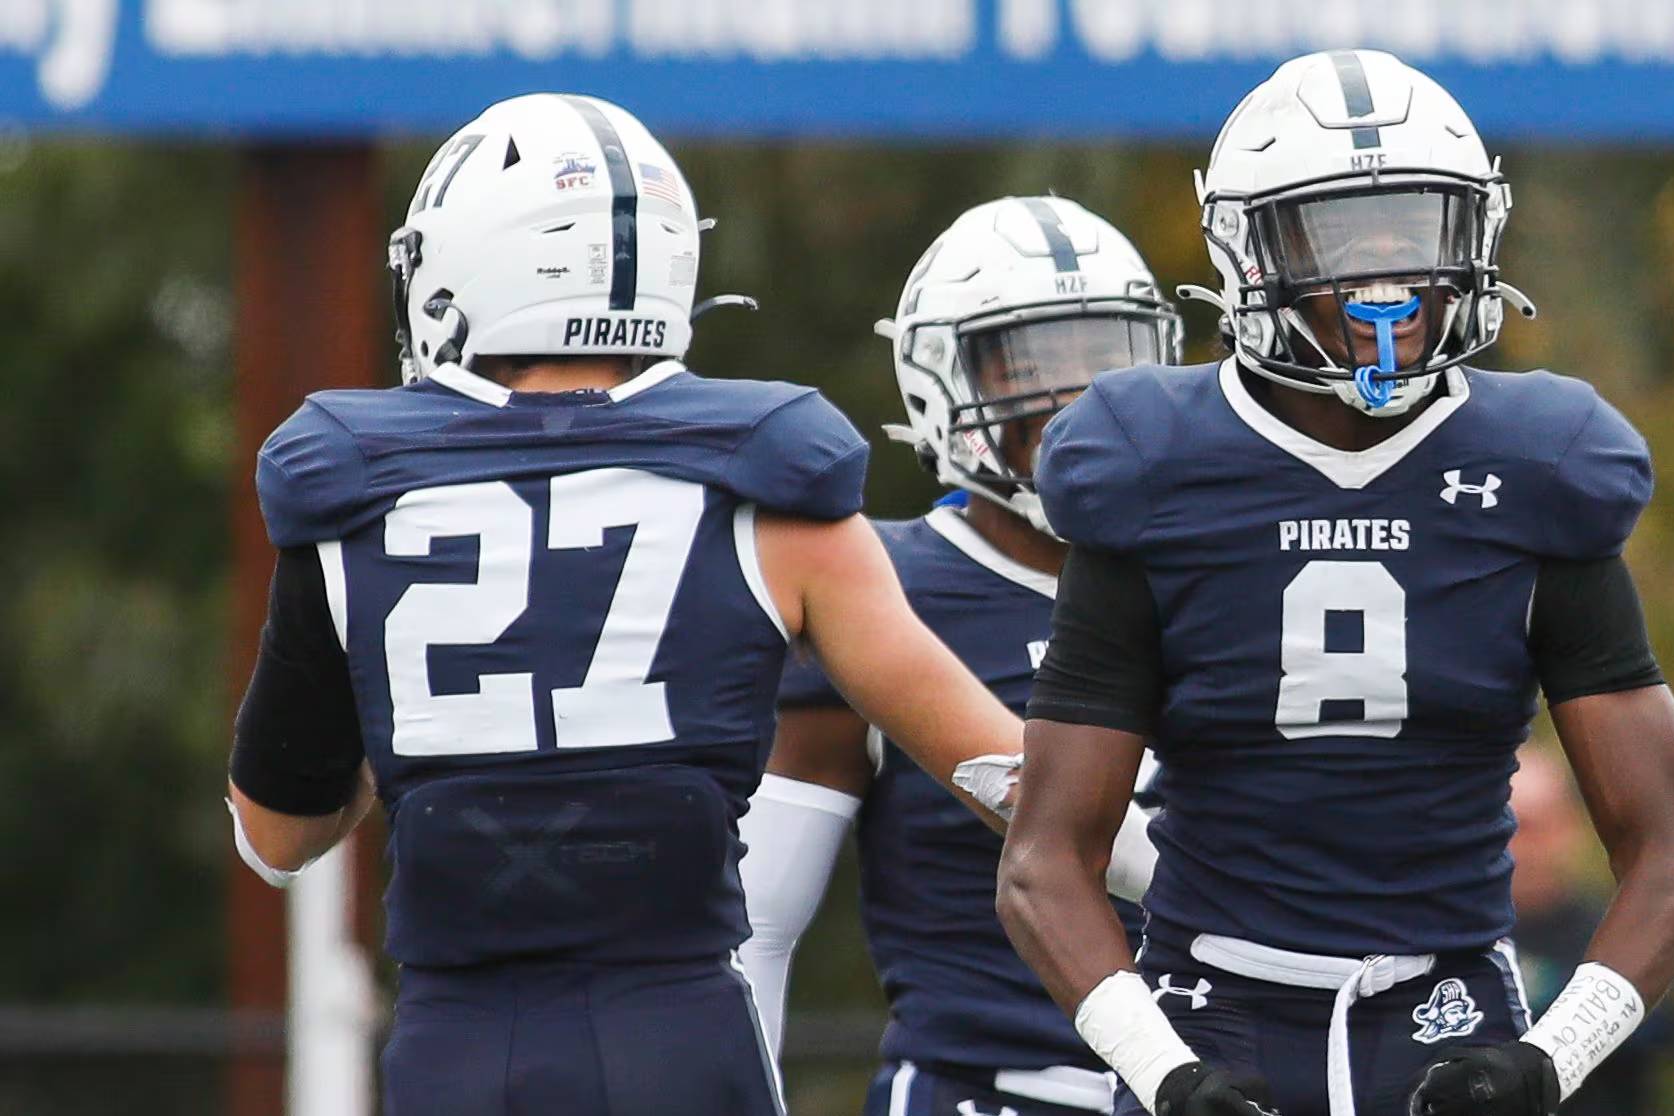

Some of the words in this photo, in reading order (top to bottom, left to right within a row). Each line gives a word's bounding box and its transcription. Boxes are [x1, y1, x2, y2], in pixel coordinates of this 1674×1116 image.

[563, 317, 666, 349] PIRATES
[1278, 518, 1412, 551] PIRATES
[384, 467, 704, 756] 27
[1275, 560, 1408, 740] 8
